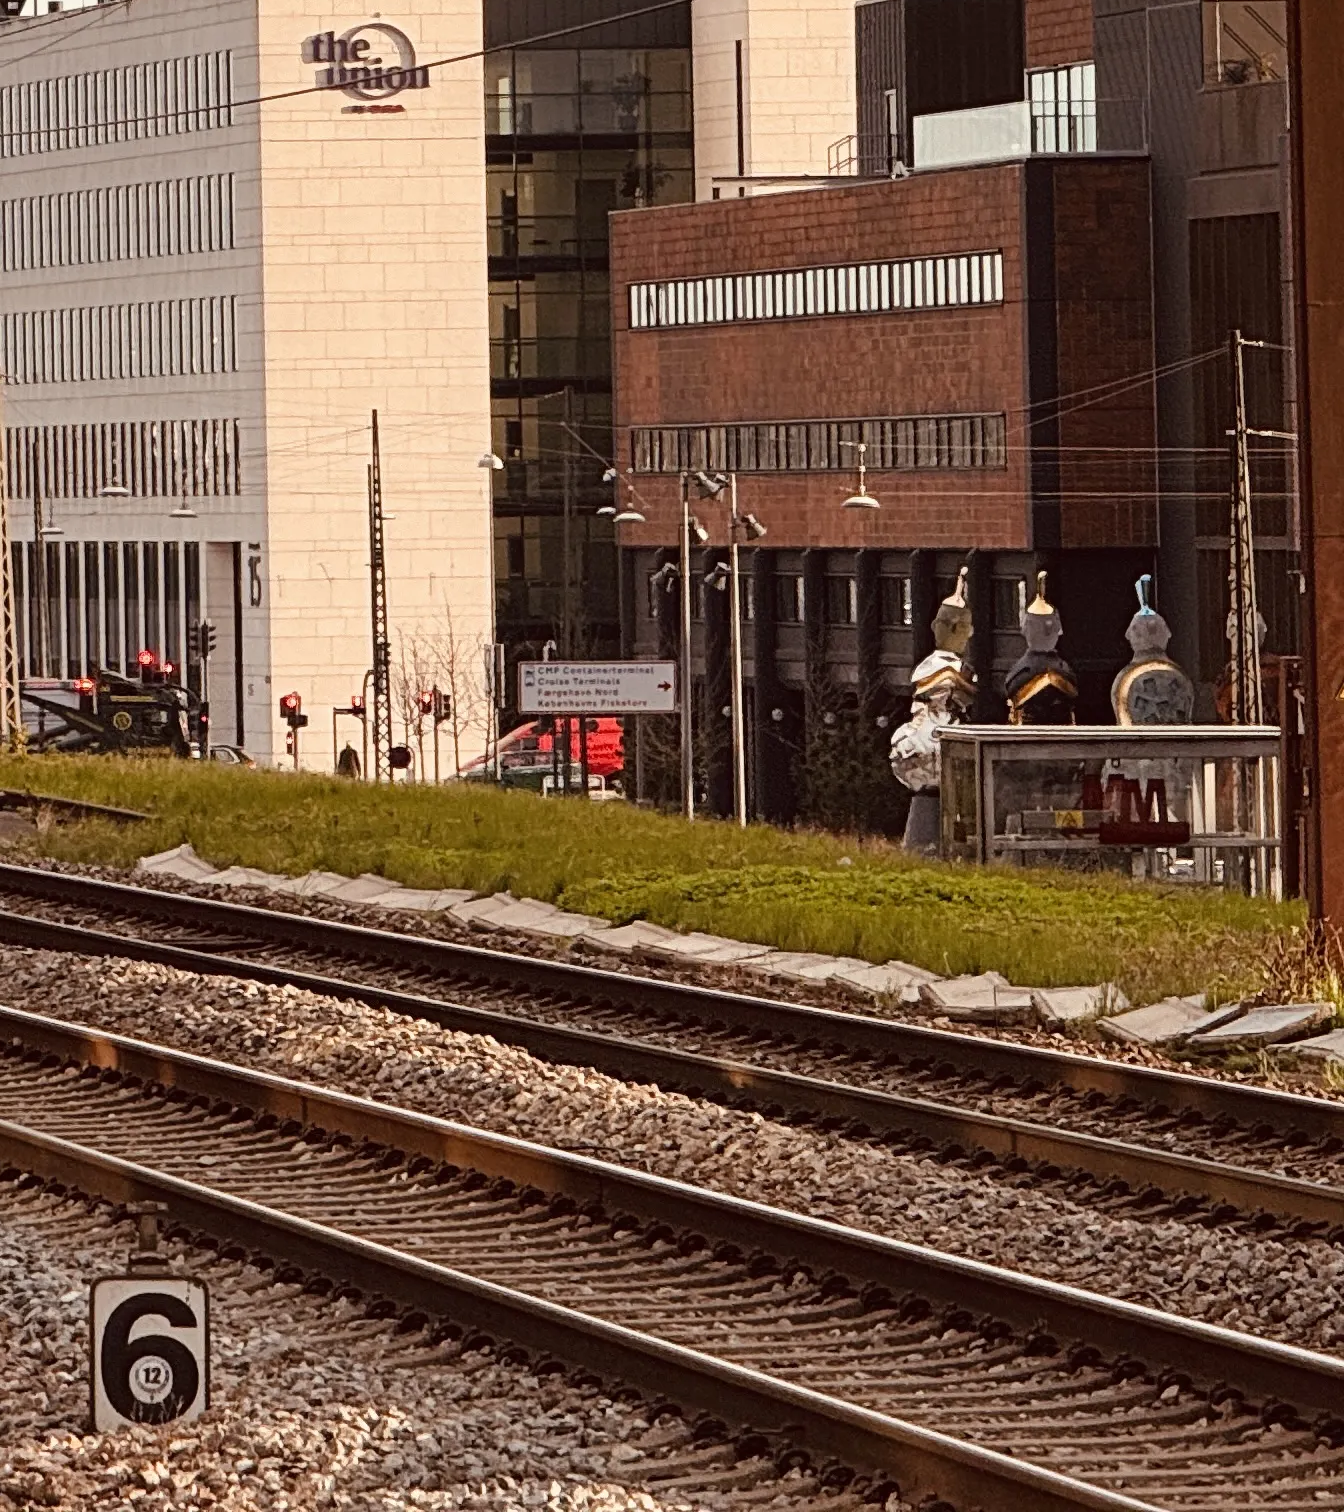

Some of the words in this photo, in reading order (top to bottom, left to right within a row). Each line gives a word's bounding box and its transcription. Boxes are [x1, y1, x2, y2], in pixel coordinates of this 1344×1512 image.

[312, 31, 371, 63] the
[101, 1292, 200, 1426] 6
[143, 1366, 163, 1385] 12
